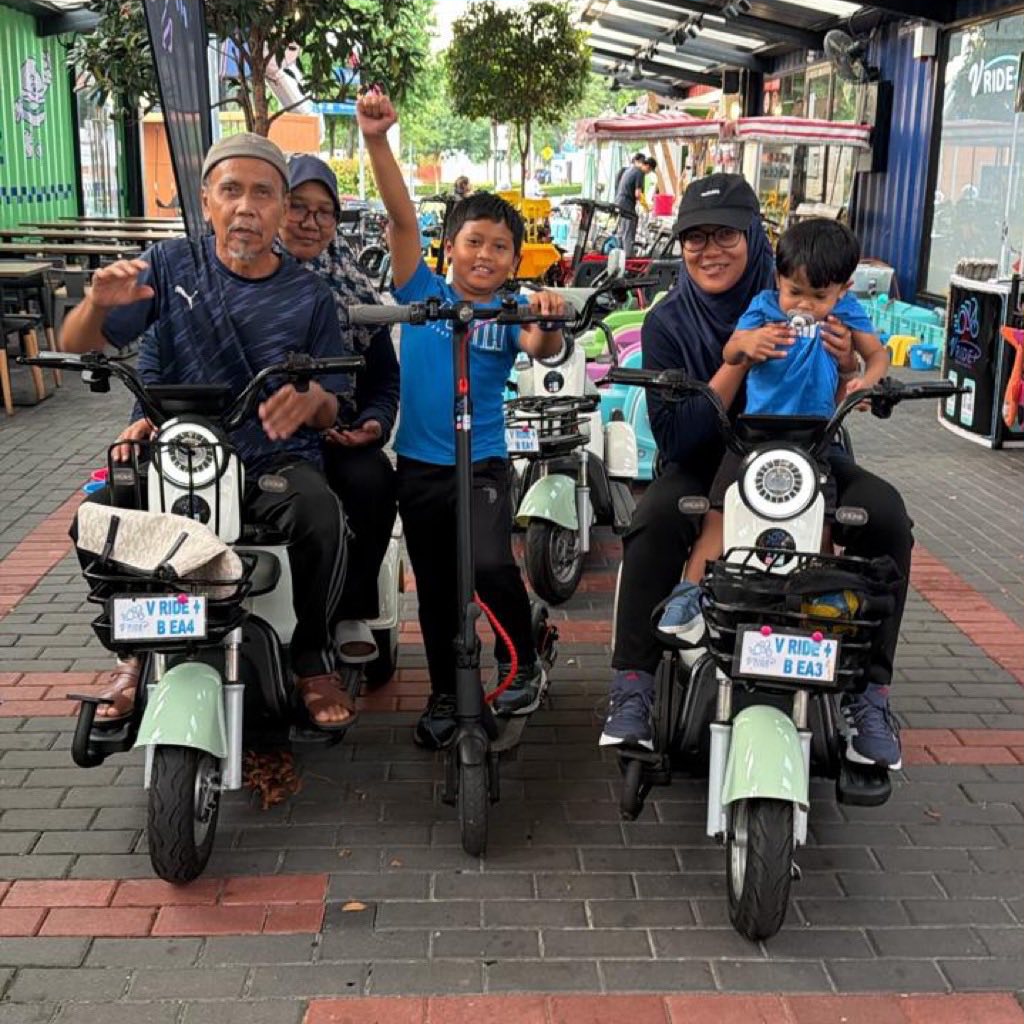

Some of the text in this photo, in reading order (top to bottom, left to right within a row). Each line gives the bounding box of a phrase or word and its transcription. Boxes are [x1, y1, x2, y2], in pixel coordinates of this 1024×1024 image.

[983, 66, 1015, 94] RIDE
[146, 600, 190, 616] V RIDE
[157, 620, 166, 635] B
[170, 619, 195, 635] EA4
[775, 637, 820, 657] V RIDE
[783, 659, 793, 674] B
[797, 660, 824, 678] EA3
